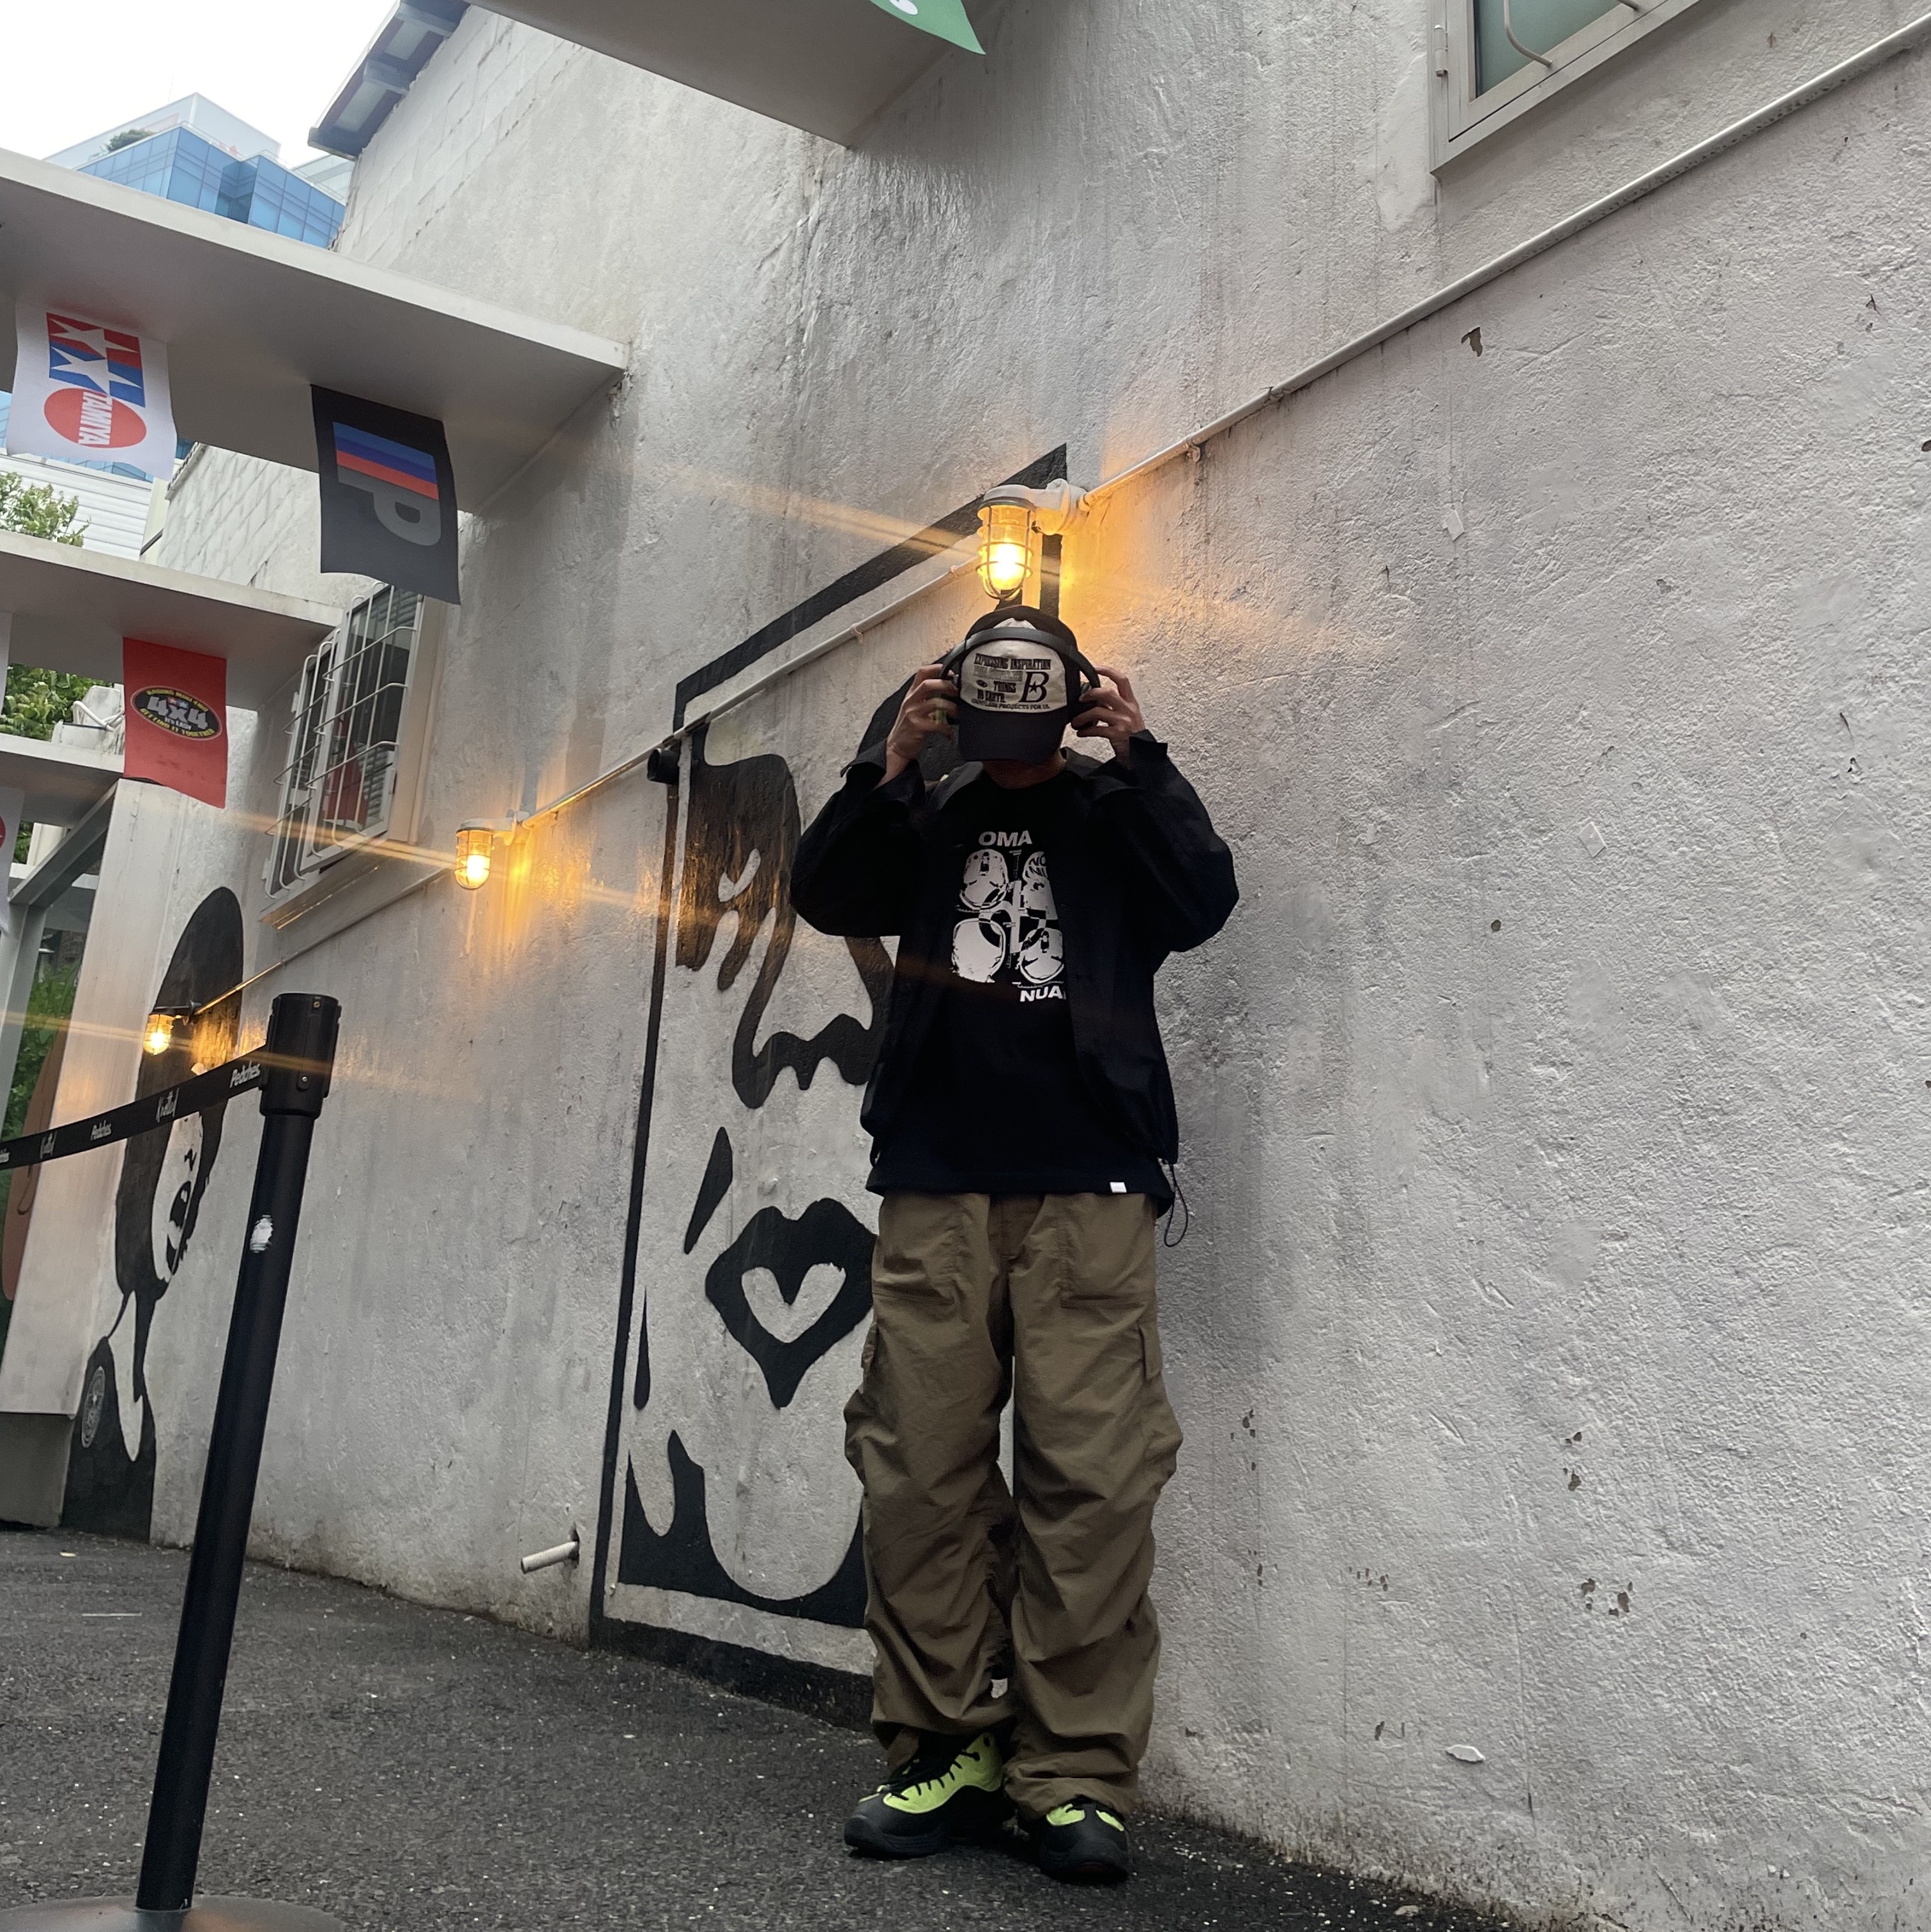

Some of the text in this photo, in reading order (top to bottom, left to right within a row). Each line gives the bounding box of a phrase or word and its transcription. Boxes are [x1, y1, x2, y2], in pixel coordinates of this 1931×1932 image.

[78, 391, 113, 445] TAMIYA
[1018, 671, 1049, 703] B
[979, 830, 1033, 847] OMA
[1020, 985, 1066, 1002] NUA
